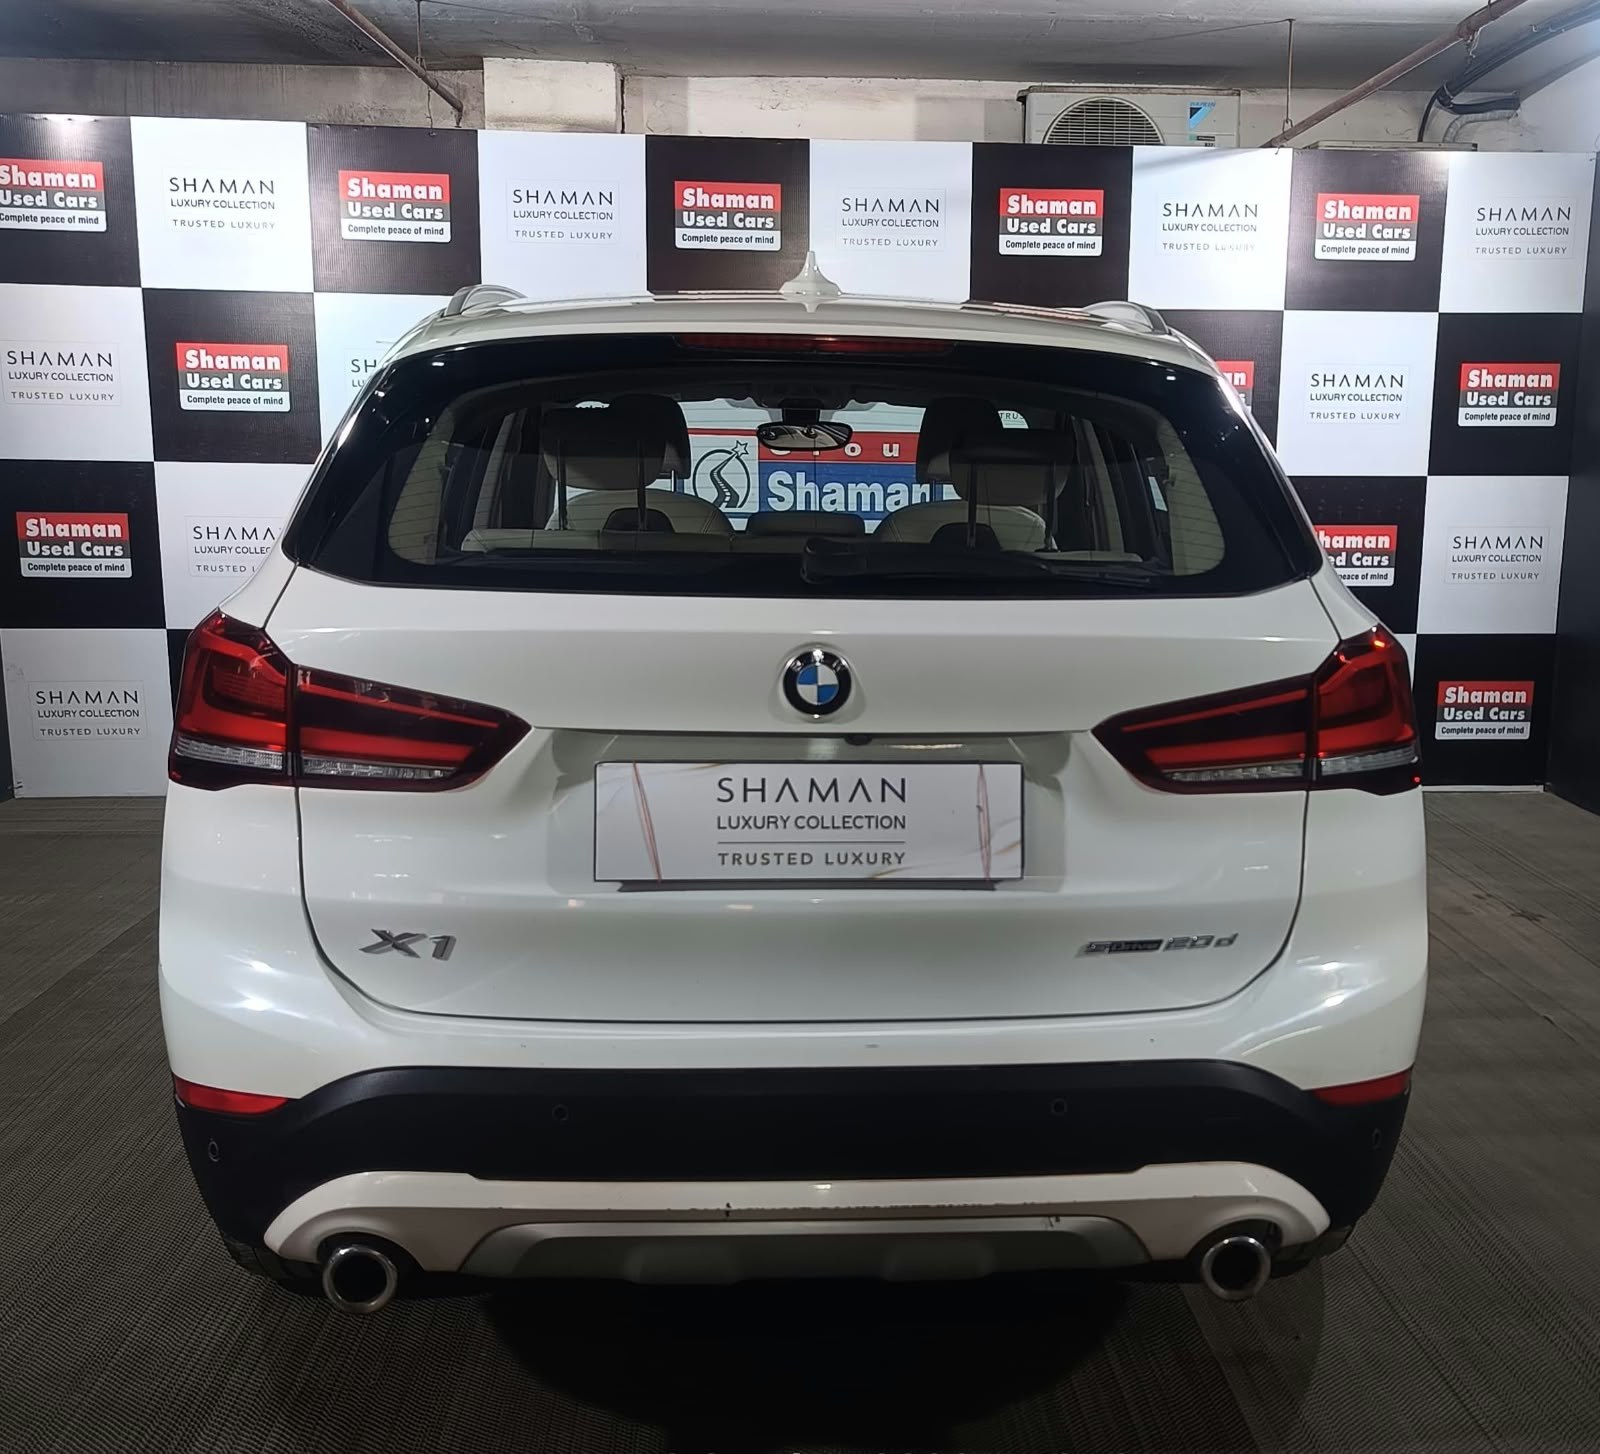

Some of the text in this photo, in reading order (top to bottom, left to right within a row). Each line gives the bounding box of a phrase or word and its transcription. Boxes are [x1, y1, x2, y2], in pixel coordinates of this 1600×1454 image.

[0, 165, 96, 188] Shaman
[170, 177, 274, 194] SHAMAN
[348, 177, 442, 200] Shaman
[54, 192, 97, 208] Cars
[171, 199, 275, 209] LUXURY COLLECTION
[513, 189, 612, 205] SHAMAN
[683, 188, 774, 209] Shaman
[1007, 194, 1096, 214] Shaman
[348, 202, 443, 219] Used Cars
[842, 198, 938, 212] SHAMAN
[1163, 203, 1257, 217] SHAMAN
[1324, 200, 1411, 220] Shaman
[0, 213, 38, 223] Complete
[41, 215, 65, 224] peace
[79, 216, 98, 224] mind
[513, 210, 613, 220] LUXURY COLLECTION
[683, 212, 774, 228] Used Cars
[1477, 207, 1570, 221] SHAMAN
[231, 221, 275, 229] LUXURY
[348, 225, 385, 234] Complete
[388, 227, 411, 235] peace
[882, 219, 938, 227] COLLECTION
[1007, 218, 1096, 233] Used Cars
[1162, 223, 1256, 232] LUXURY COLLECTION
[515, 230, 564, 238] TRUSTED
[1323, 223, 1410, 239] Used Cars
[1514, 227, 1569, 235] COLLECTION
[682, 234, 718, 243] Complete
[720, 236, 743, 244] peace
[755, 236, 774, 244] mind
[843, 238, 891, 246] TRUSTED
[1006, 240, 1040, 249] Complete
[1322, 245, 1356, 254] Complete
[7, 351, 112, 367] SHAMAN
[186, 349, 280, 370] Shaman
[9, 372, 113, 381] LUXURY COLLECTION
[186, 373, 282, 389] Used Cars
[1311, 374, 1403, 388] SHAMAN
[1468, 369, 1552, 388] Shaman
[11, 392, 63, 400] TRUSTED
[187, 395, 225, 405] Complete
[228, 397, 251, 405] peace
[264, 397, 283, 405] mind
[1310, 393, 1346, 401] LUXURY
[1467, 391, 1551, 406] Used Cars
[1465, 413, 1498, 422] Complete
[1500, 414, 1521, 422] peace
[768, 471, 930, 512] Shaman
[26, 518, 121, 537] Shaman
[193, 526, 275, 540] SHAMA
[1315, 530, 1390, 548] haman
[1453, 536, 1543, 549] SHAMAN
[27, 541, 123, 556] Used Cars
[1352, 552, 1389, 566] Cars
[1488, 554, 1541, 562] COLLECTION
[28, 563, 65, 572] Complete
[68, 564, 92, 572] peace
[36, 690, 138, 704] SHAMAN
[1445, 686, 1526, 703] Shaman
[38, 709, 139, 718] LUXURY COLLECTION
[1444, 707, 1525, 720] Used Cars
[1442, 727, 1473, 735] Complete
[1476, 727, 1496, 735] peace
[717, 778, 906, 803] SHAMAN
[717, 815, 905, 829] LUXURY COLLECTION
[718, 852, 905, 865] TRUSTED LUXURY
[359, 929, 456, 961] X1
